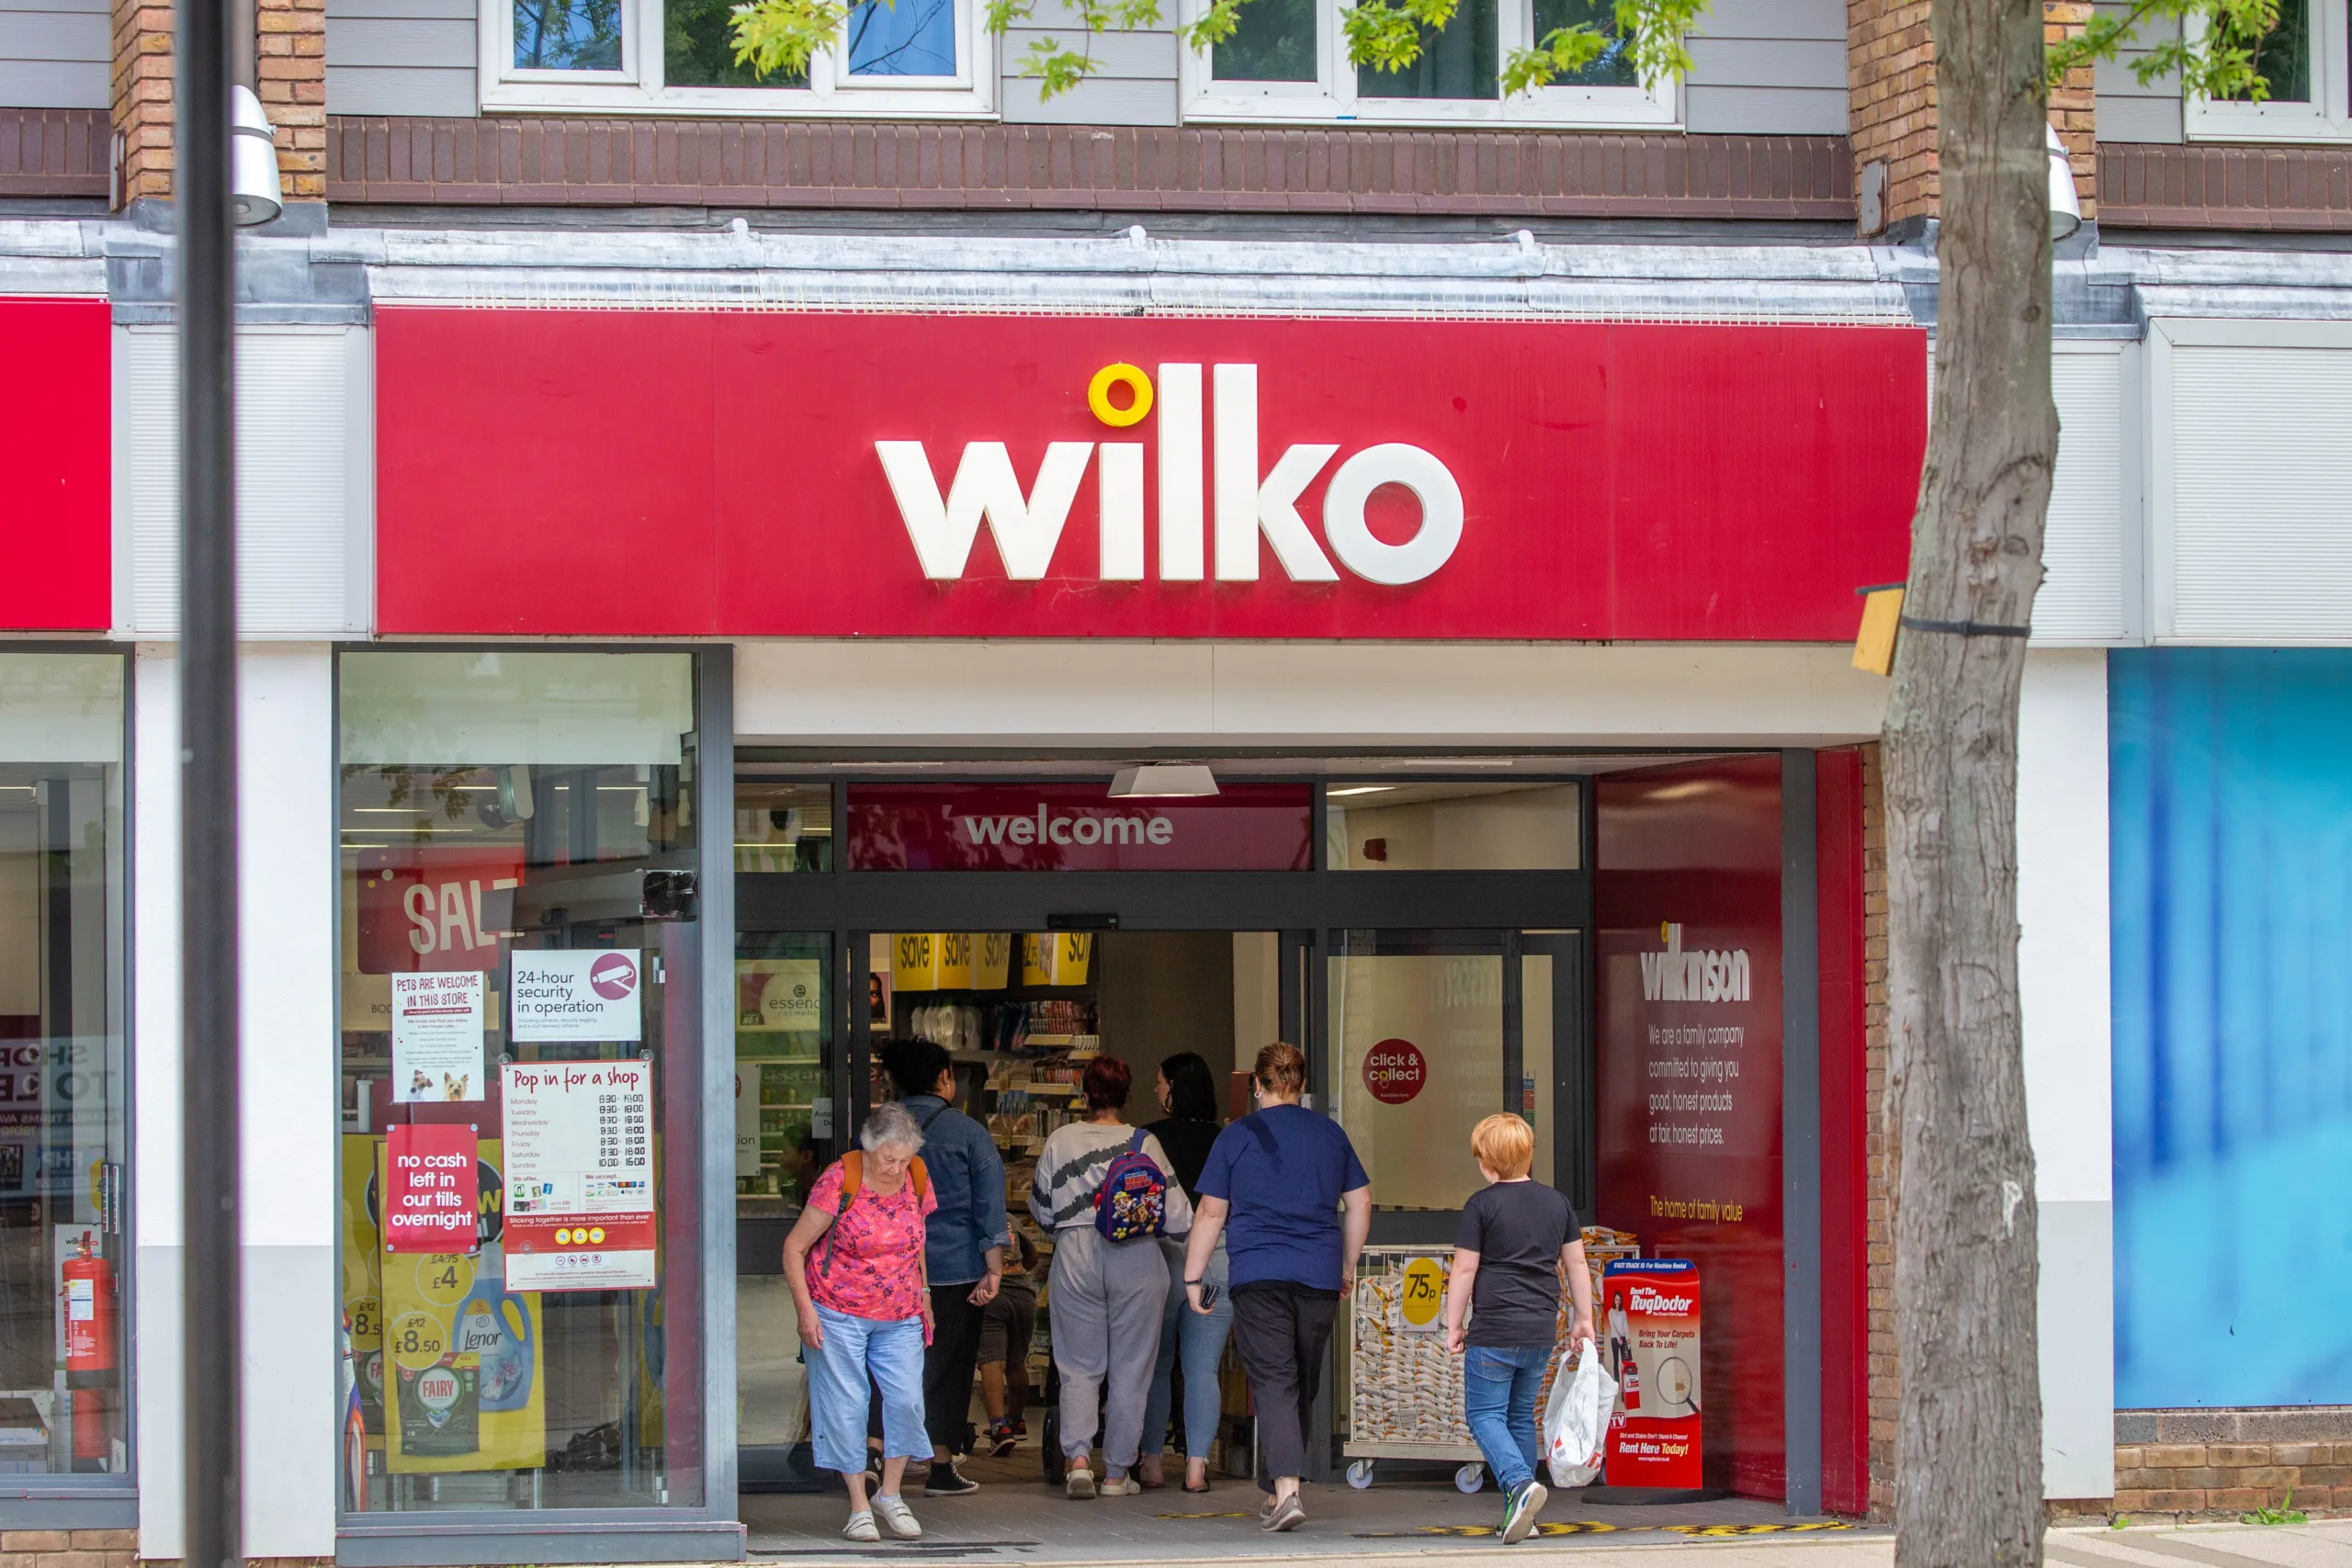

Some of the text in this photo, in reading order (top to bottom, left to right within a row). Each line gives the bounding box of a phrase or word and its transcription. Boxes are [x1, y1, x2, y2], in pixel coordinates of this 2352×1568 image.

[874, 362, 1464, 586] wilko
[965, 803, 1173, 844] welcome
[901, 934, 930, 968] save
[944, 933, 971, 967] save
[397, 975, 478, 991] PETS ARE WELCOME
[517, 970, 575, 984] 24-hour
[407, 992, 468, 1007] IN THIS STORE
[517, 985, 573, 1001] security
[517, 999, 604, 1017] in operation
[1649, 1024, 1744, 1048] We are a family company
[1370, 1054, 1419, 1066] click &
[1369, 1067, 1420, 1080] collect
[1649, 1057, 1739, 1083] committed to giving you
[514, 1066, 639, 1093] Pop in for a shop
[1649, 1090, 1733, 1115] good, honest products
[1650, 1122, 1724, 1148] at fair, honest prices.
[398, 1153, 467, 1168] no cash
[410, 1171, 455, 1187] left in
[402, 1194, 432, 1207] our
[435, 1191, 462, 1207] tills
[1650, 1195, 1743, 1224] The home of family value
[391, 1211, 472, 1230] overnight
[587, 1214, 618, 1223] important
[433, 1266, 458, 1289] £4
[1408, 1274, 1436, 1303] 75p
[1630, 1287, 1657, 1295] Rent The
[394, 1329, 440, 1354] £8.50
[464, 1330, 503, 1351] Lenor
[1639, 1329, 1695, 1339] Bring Your Carpets
[1639, 1340, 1678, 1348] Back To Life!
[423, 1380, 454, 1397] FAIRY
[1611, 1415, 1625, 1427] TV
[1619, 1441, 1689, 1457] Rent Here Today!
